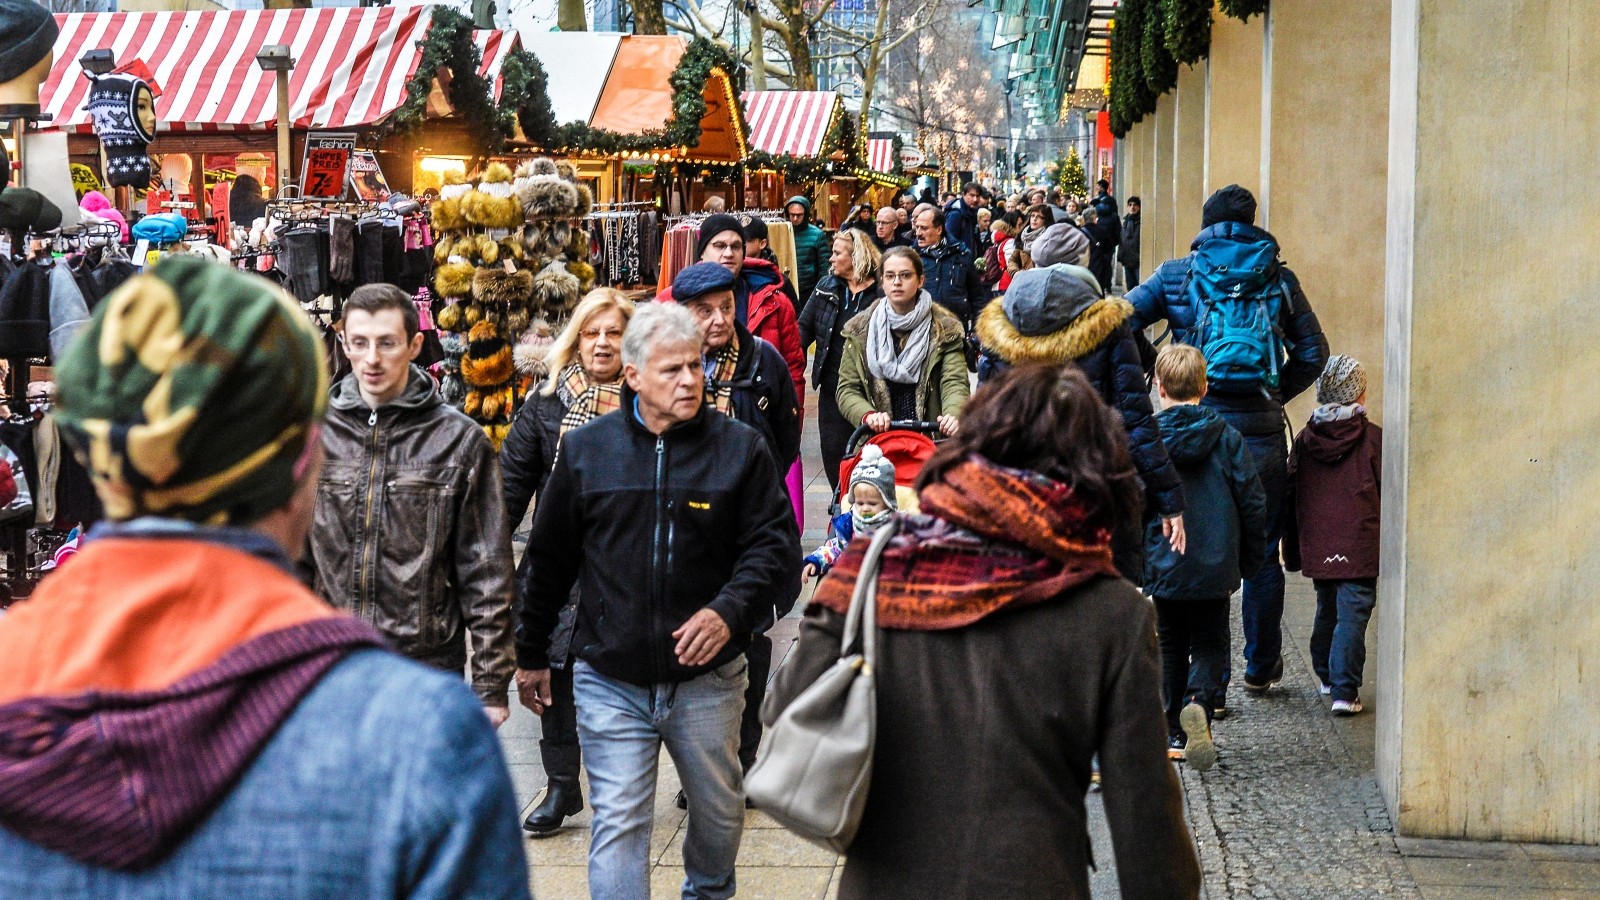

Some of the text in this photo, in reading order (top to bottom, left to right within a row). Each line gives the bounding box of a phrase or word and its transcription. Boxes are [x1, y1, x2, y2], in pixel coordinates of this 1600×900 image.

[319, 139, 353, 149] fashion
[312, 151, 342, 161] SUPER
[312, 161, 340, 170] PREIS
